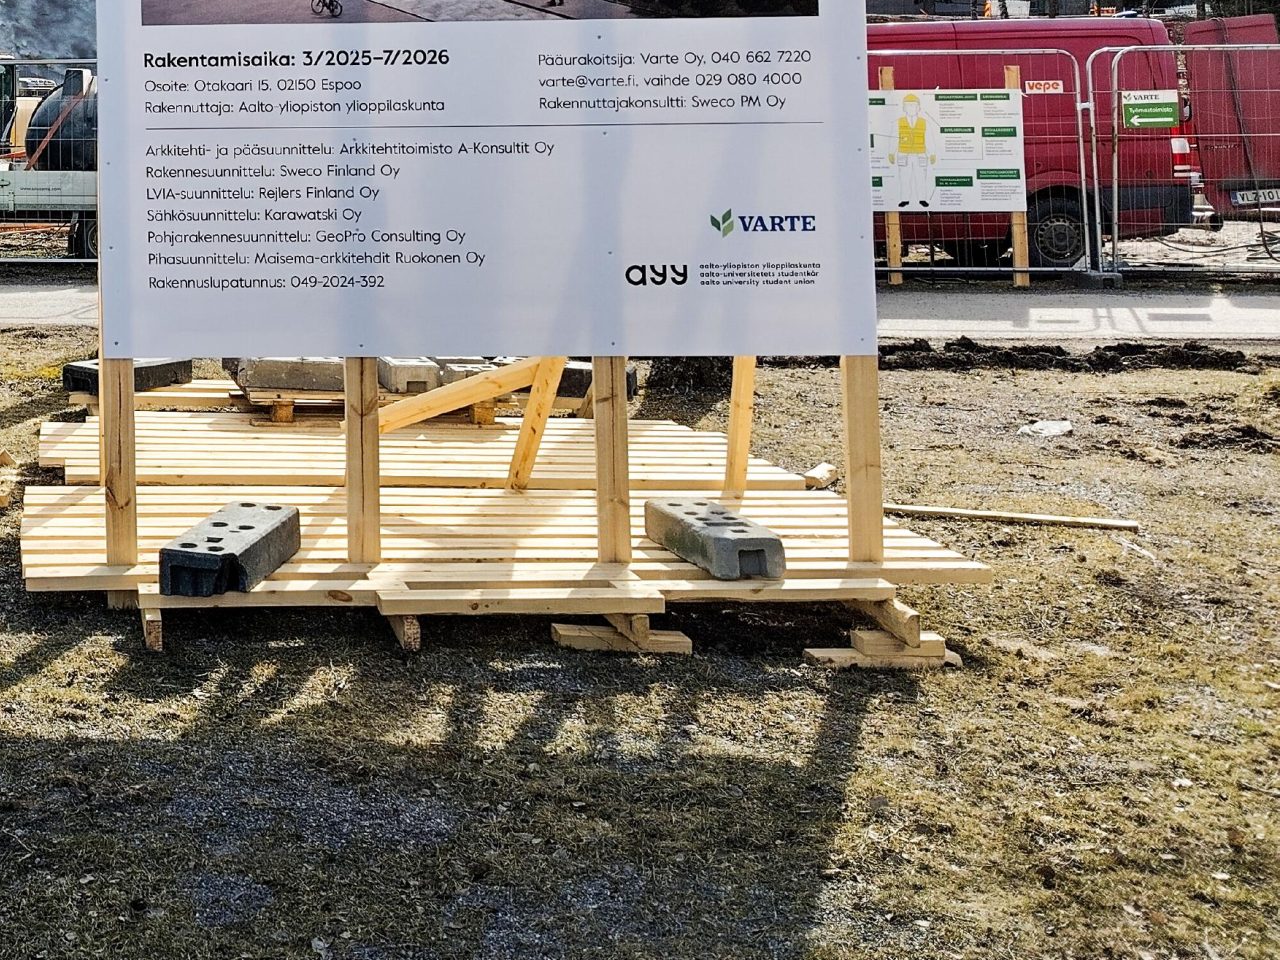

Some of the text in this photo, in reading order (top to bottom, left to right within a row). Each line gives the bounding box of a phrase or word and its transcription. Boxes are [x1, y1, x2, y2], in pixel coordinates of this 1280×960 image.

[143, 50, 296, 69] Rakentamisaika:
[537, 52, 635, 69] Pääurakoitsija:
[639, 52, 680, 65] Varte
[710, 50, 741, 64] 040
[745, 50, 772, 64] 662
[776, 49, 812, 63] 7220
[144, 79, 190, 93] Osoite:
[193, 79, 253, 92] Otakaari
[276, 78, 317, 92] 02150
[321, 78, 362, 94] Espoo
[643, 73, 691, 87] vaihde
[695, 73, 723, 87] 029
[726, 72, 757, 86] 080
[762, 72, 803, 86] 4000
[1027, 81, 1060, 93] vepe
[144, 98, 445, 117] Rakennuttaja: Aalto-yliopiston ylioppilaskunta
[539, 94, 787, 113] Rakennuttajakonsultti: Sweco PM Oy
[145, 140, 555, 160] Arkkitehti- ja pääsuunnittelu: Arkkitehtitoimisto A-Konsultit Oy
[145, 163, 401, 180] Rakennesuunnittelu: Sweco Finland Oy
[146, 185, 381, 203] LVIA-suunnittelu: Rejlers Finland Oy
[146, 207, 363, 224] Sähkösuunnittelu: Karawatski Oy
[737, 214, 817, 233] VARTE
[147, 227, 467, 247] Pohjarakennesuunnittelu: GeoPro Consulting Oy
[148, 251, 486, 268] Pihasuunnittelu: Maisema-arkkitehdit Ruokonen Oy
[762, 261, 821, 270] ylioppilaskunta
[148, 275, 385, 292] Rakennuslupatunnus: 049-2024-392
[624, 264, 689, 287] ayy
[700, 278, 720, 286] aalto
[762, 277, 791, 285] student
[794, 277, 815, 285] union
